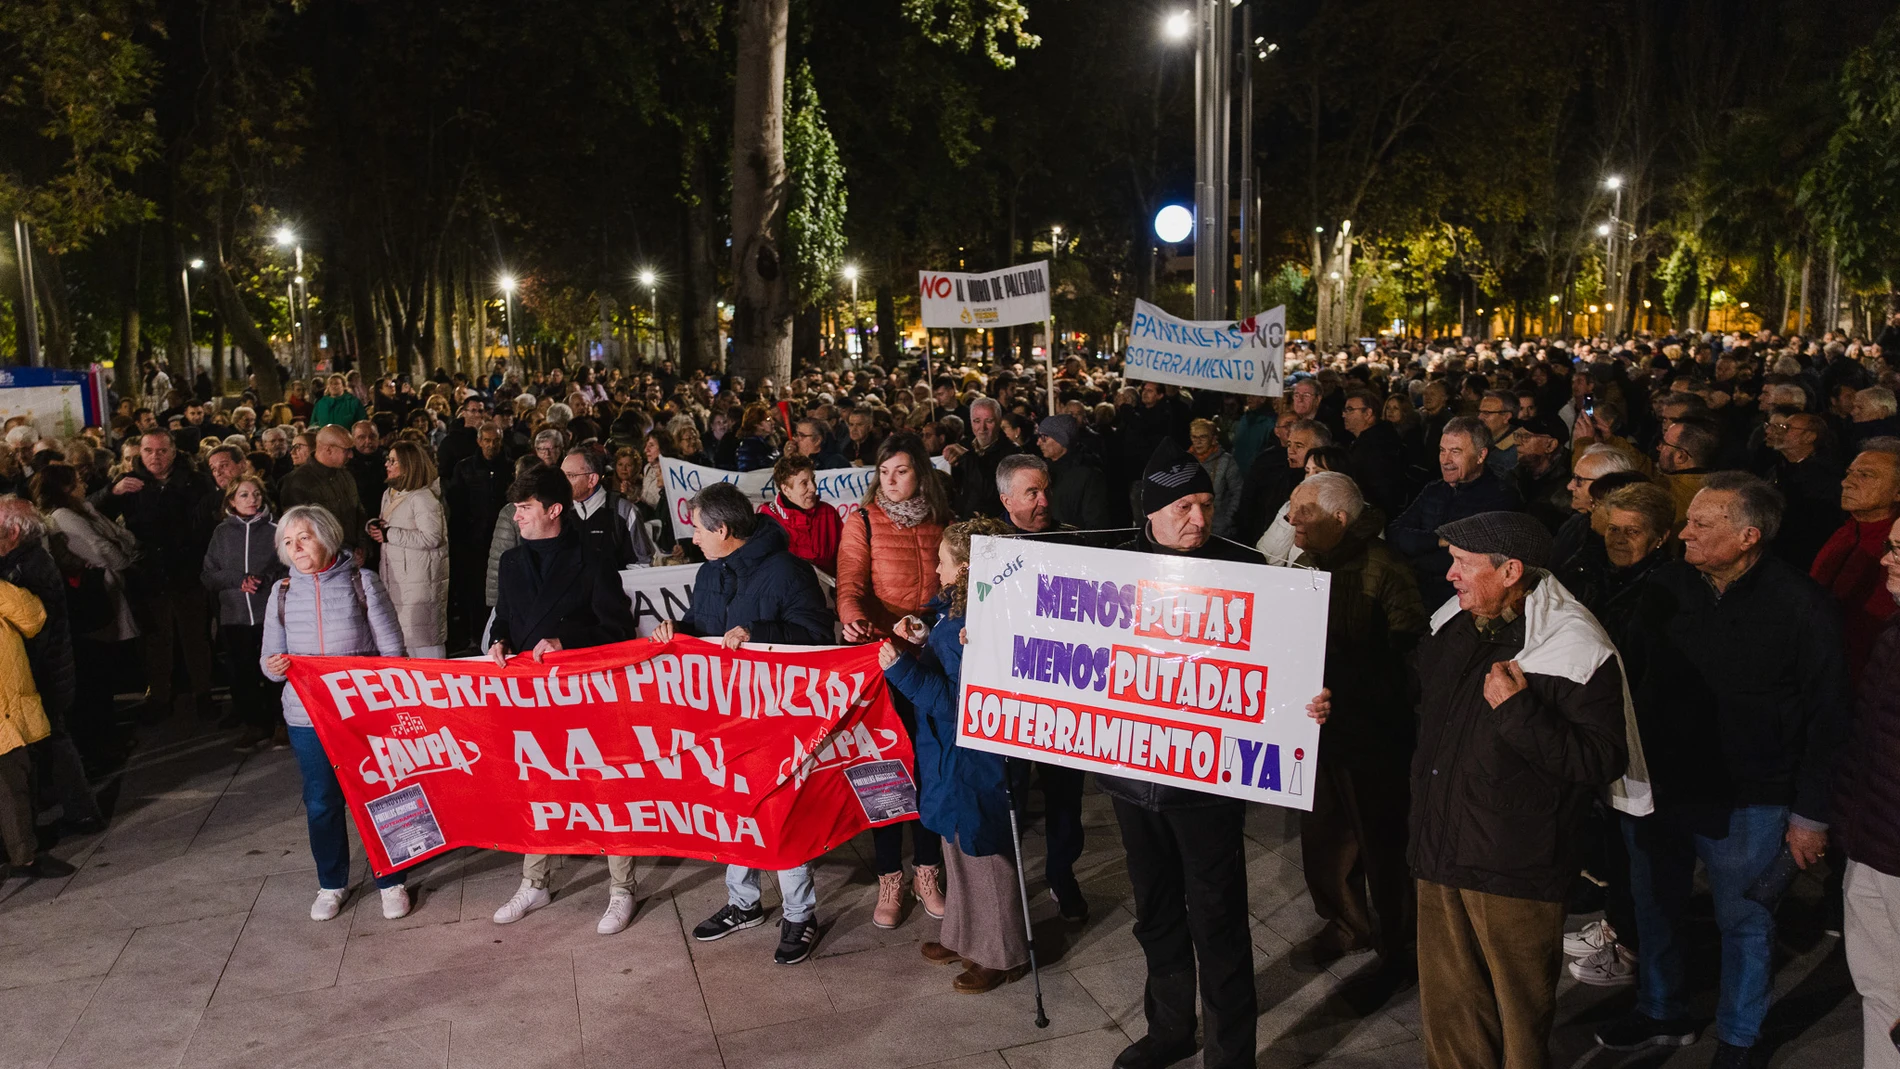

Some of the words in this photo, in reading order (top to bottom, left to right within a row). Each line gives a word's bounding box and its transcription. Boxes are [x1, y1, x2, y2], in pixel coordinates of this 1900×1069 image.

[920, 275, 952, 299] NO
[990, 276, 1004, 301] DE
[1003, 268, 1046, 298] PALENCIA
[1133, 313, 1244, 349] PANTALLAS
[1251, 322, 1283, 348] NO
[1125, 346, 1254, 381] SOTERRAMIENTO
[1261, 360, 1280, 388] YA
[669, 466, 702, 492] NO
[992, 555, 1024, 585] adif
[1036, 573, 1137, 629] MENOS
[1139, 586, 1247, 644] PUTAS
[320, 666, 620, 721] FEDERACIÓN
[625, 654, 875, 721] PROVINCIAL
[1012, 634, 1110, 692] MENOS
[1113, 649, 1263, 717] PUTADAS
[366, 726, 473, 792] FAVPA
[967, 691, 1216, 779] SOTERRAMIENTO
[528, 800, 766, 848] PALENCIA
